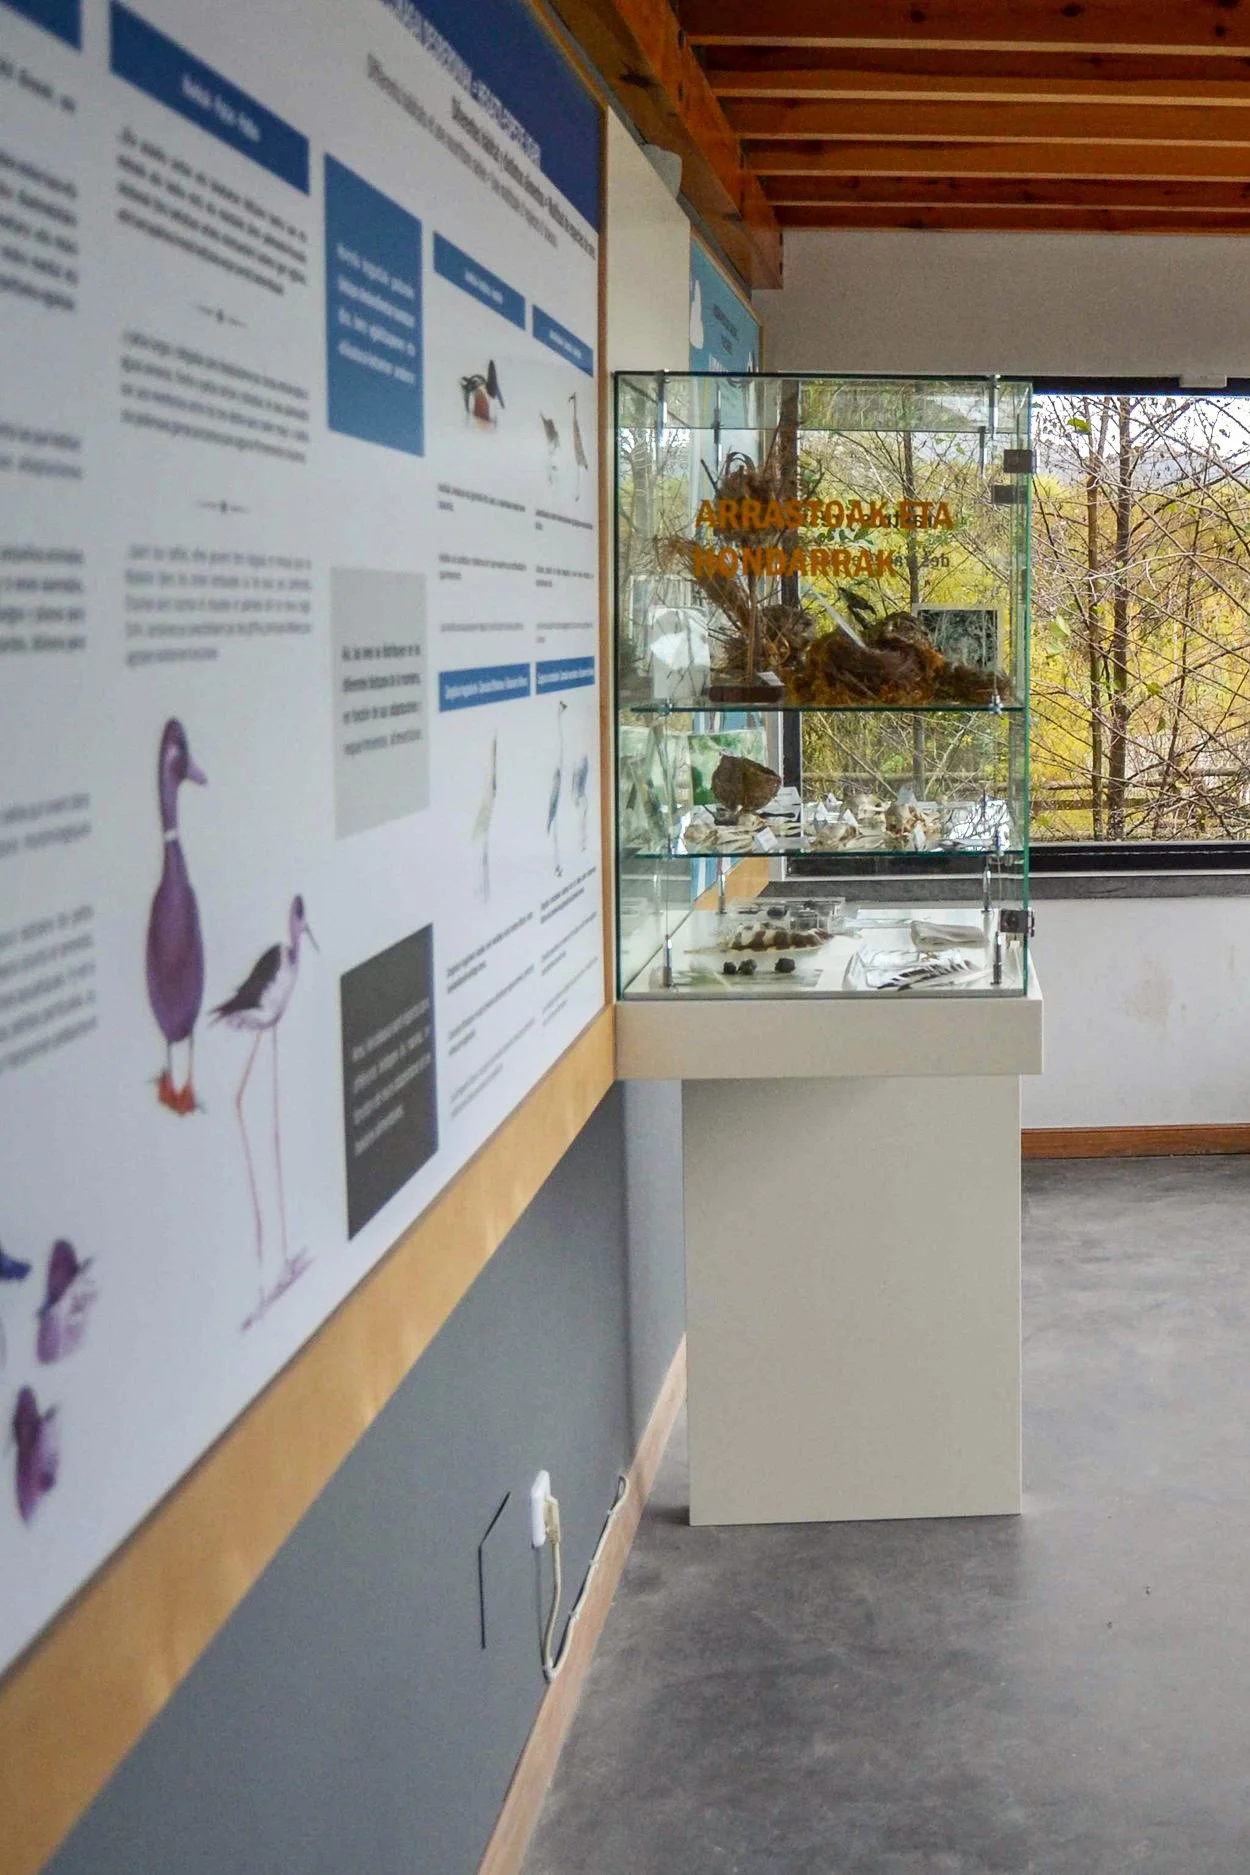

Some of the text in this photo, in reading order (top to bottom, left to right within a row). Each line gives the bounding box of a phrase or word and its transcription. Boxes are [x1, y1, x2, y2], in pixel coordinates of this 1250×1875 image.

[695, 499, 889, 529] ARRASTOAK
[899, 501, 954, 530] ETA
[693, 546, 897, 578] HONDARRAK
